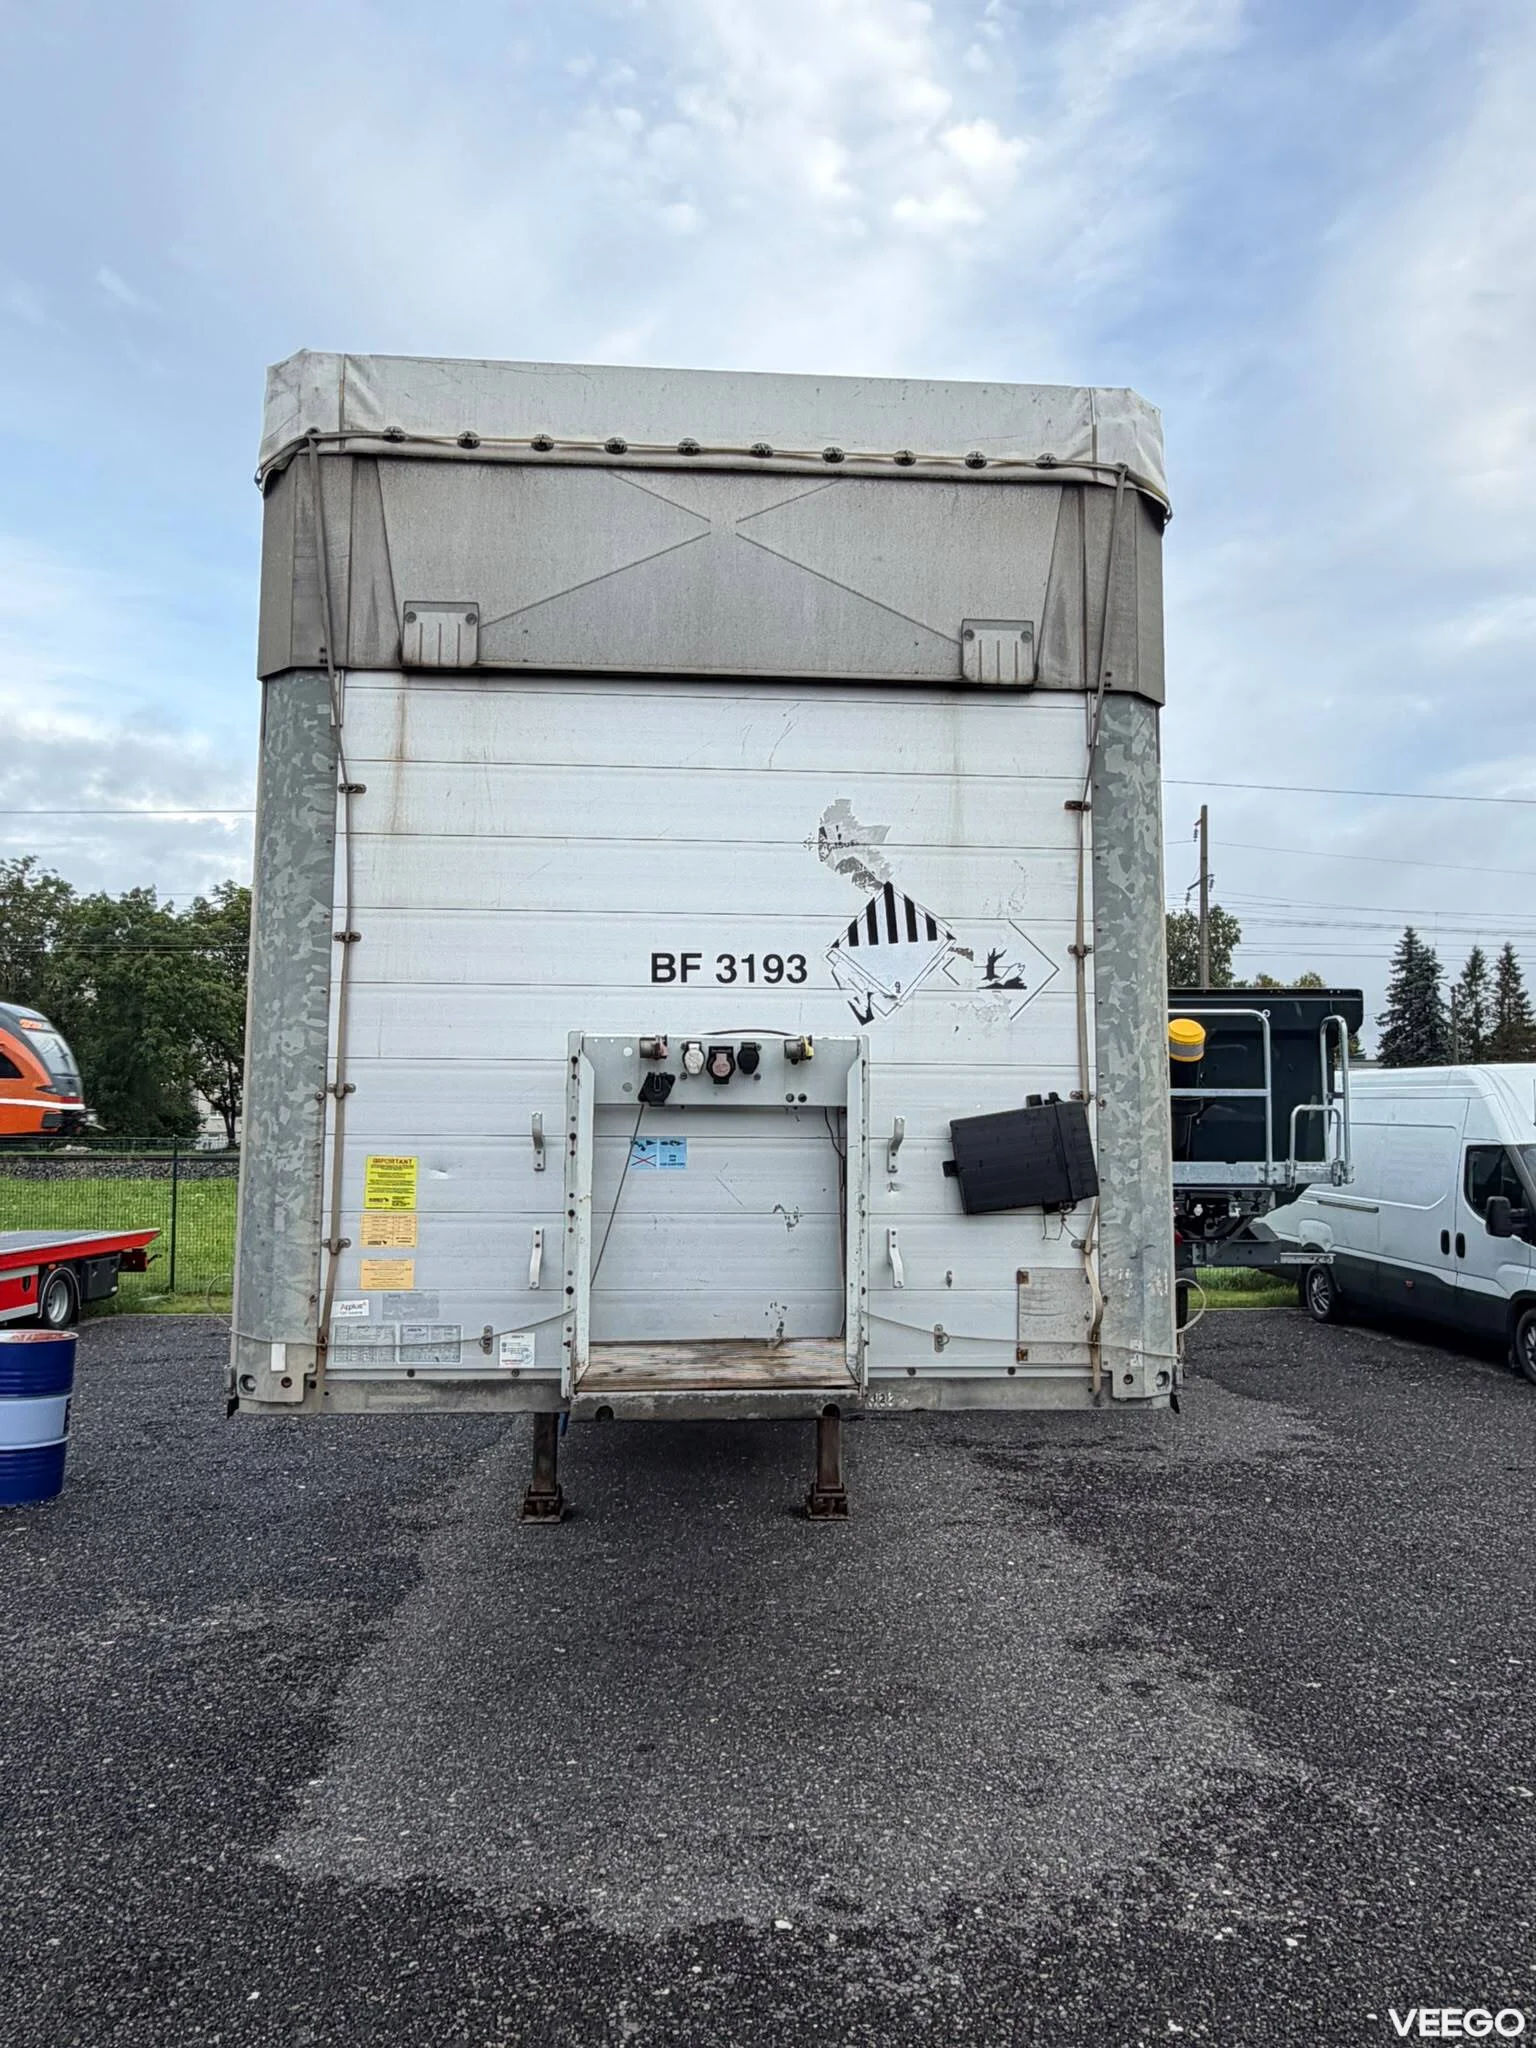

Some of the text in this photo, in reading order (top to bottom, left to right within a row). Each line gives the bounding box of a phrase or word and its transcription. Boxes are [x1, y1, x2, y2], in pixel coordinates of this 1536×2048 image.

[651, 952, 808, 984] BF 3193
[894, 981, 901, 994] 9
